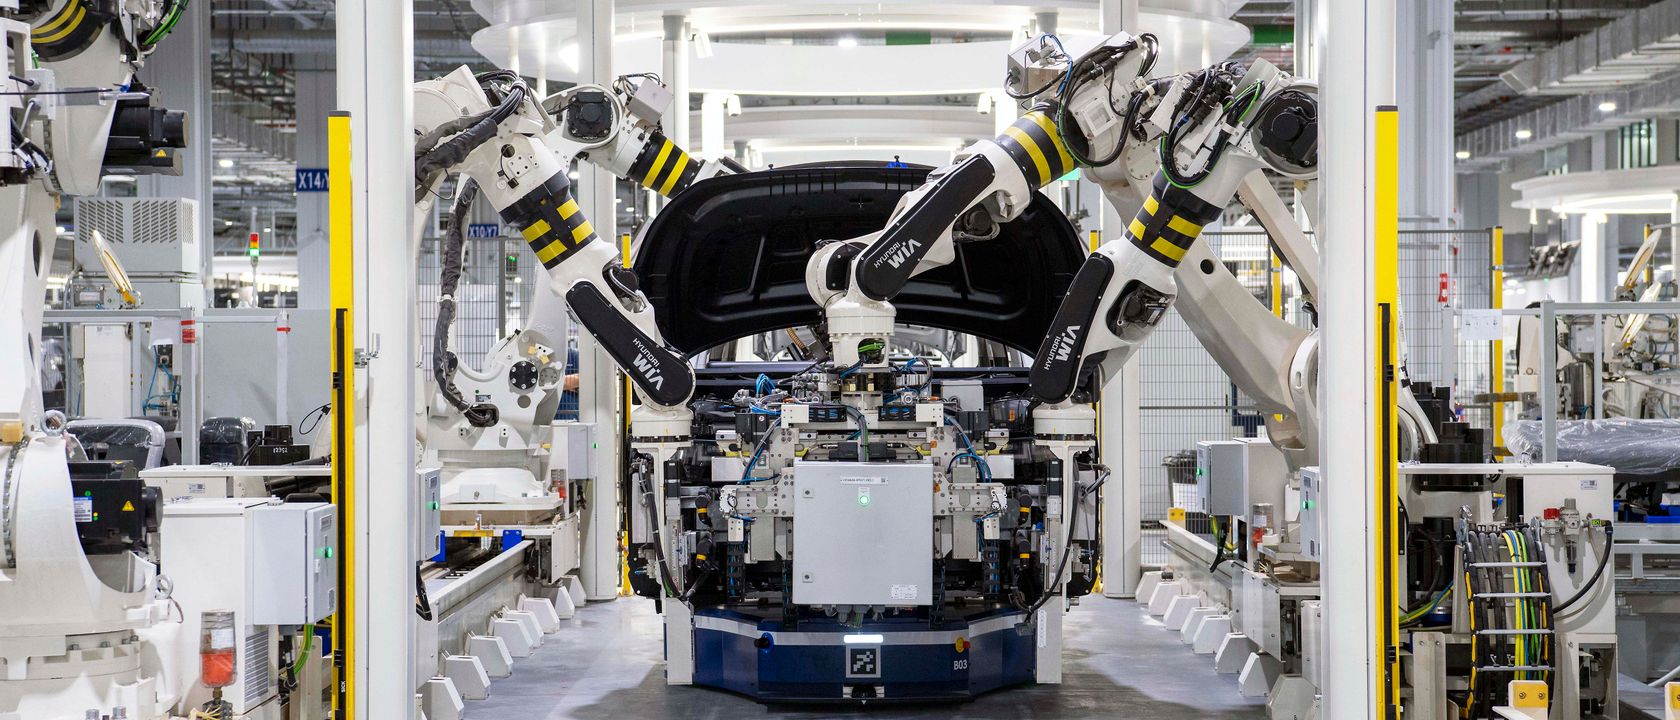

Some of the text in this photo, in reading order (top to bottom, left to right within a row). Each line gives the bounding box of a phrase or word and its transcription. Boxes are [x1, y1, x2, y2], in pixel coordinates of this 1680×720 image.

[468, 225, 498, 238] X10/Y7
[873, 241, 901, 269] HYUNDAI
[632, 337, 661, 368] HYUNDAI
[1043, 335, 1062, 371] HYUNDAI
[953, 659, 968, 671] B03
